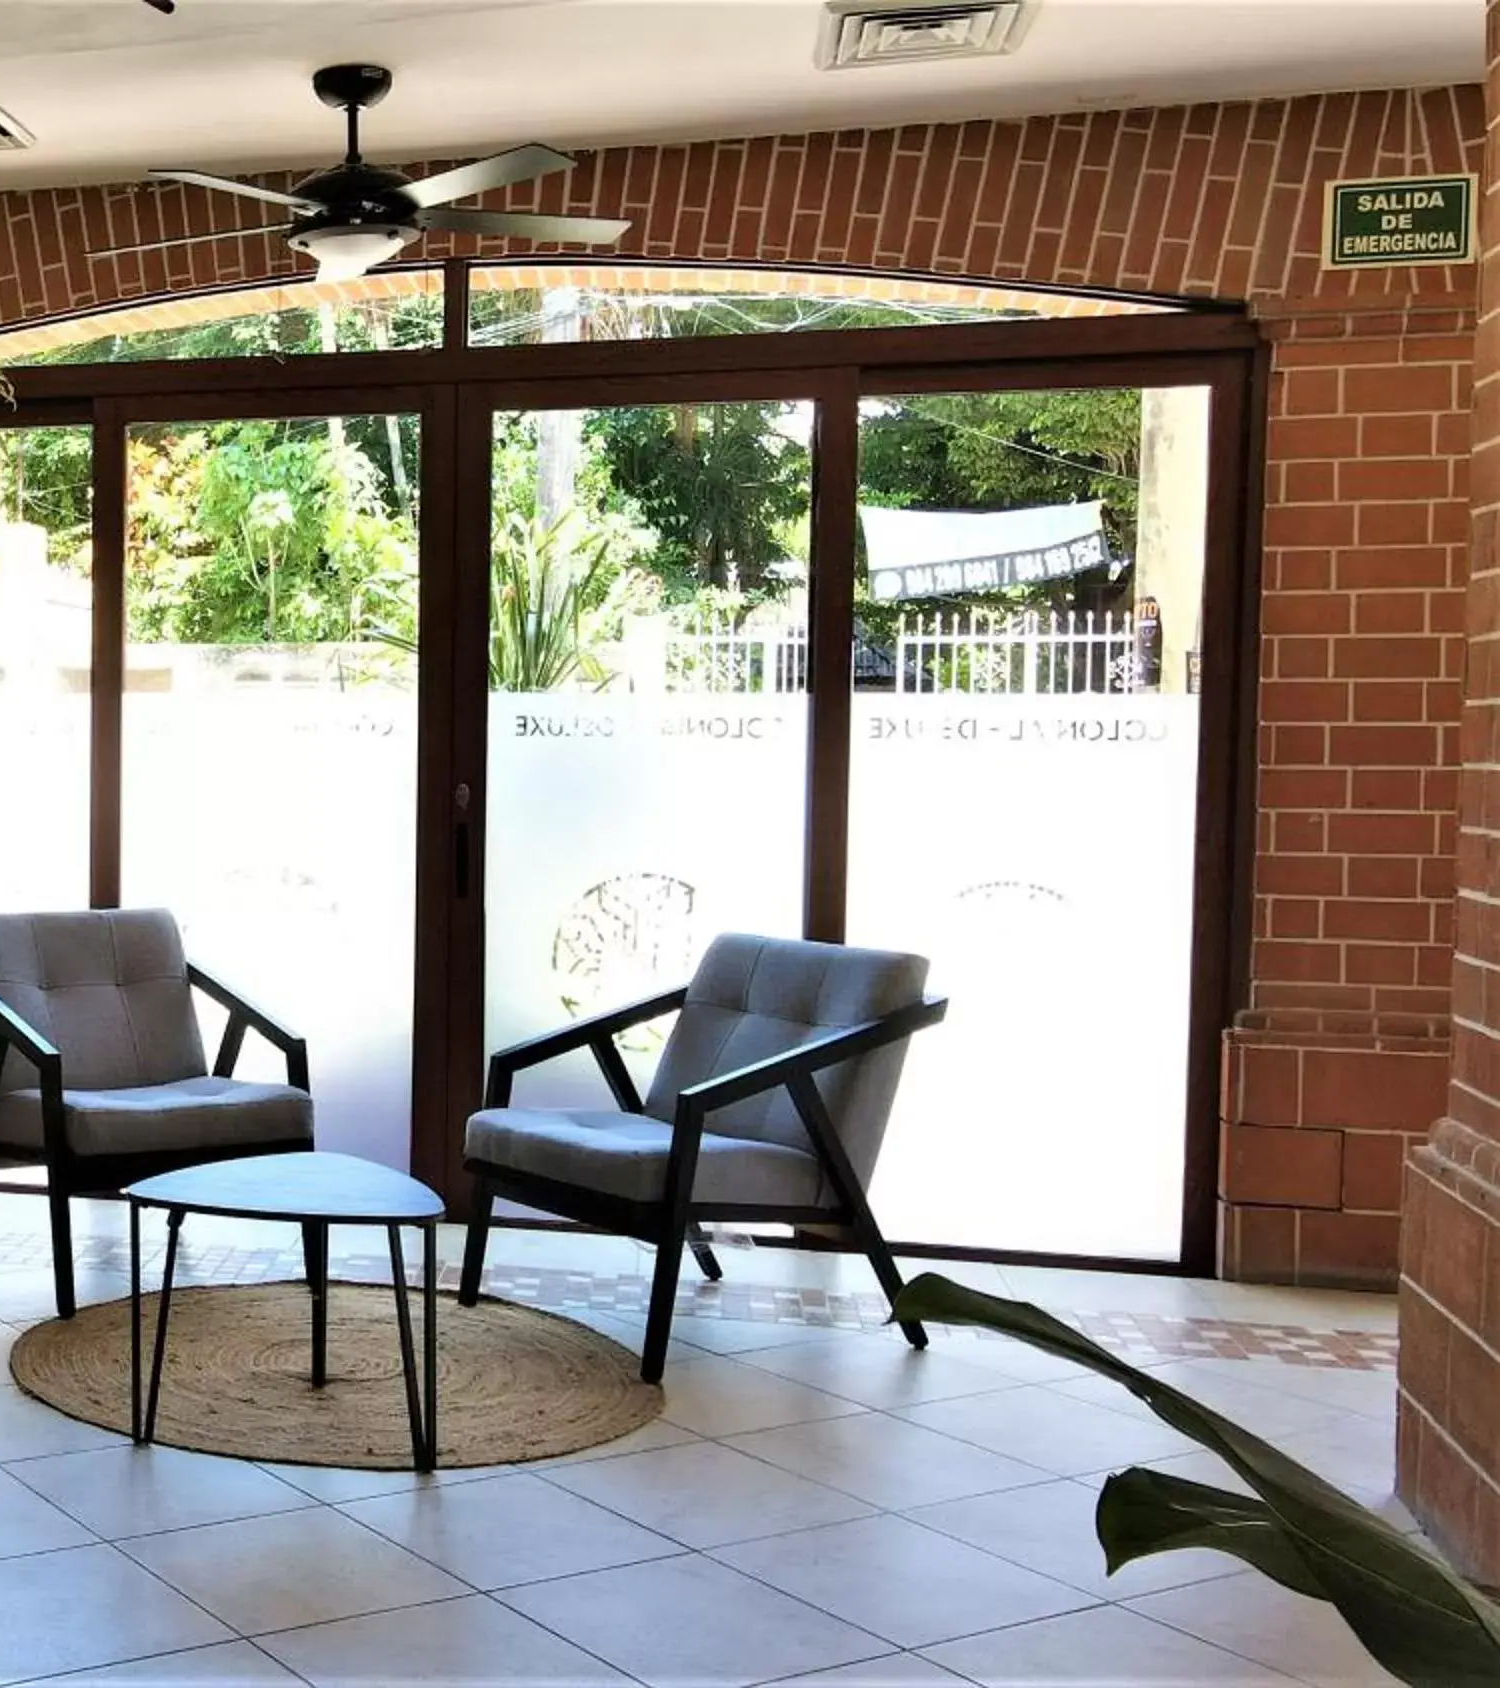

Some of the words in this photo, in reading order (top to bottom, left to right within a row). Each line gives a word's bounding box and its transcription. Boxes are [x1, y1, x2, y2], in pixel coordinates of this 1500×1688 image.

[1357, 191, 1444, 212] SALIDA
[1381, 213, 1413, 231] DE
[1343, 231, 1457, 255] EMERGENCIA
